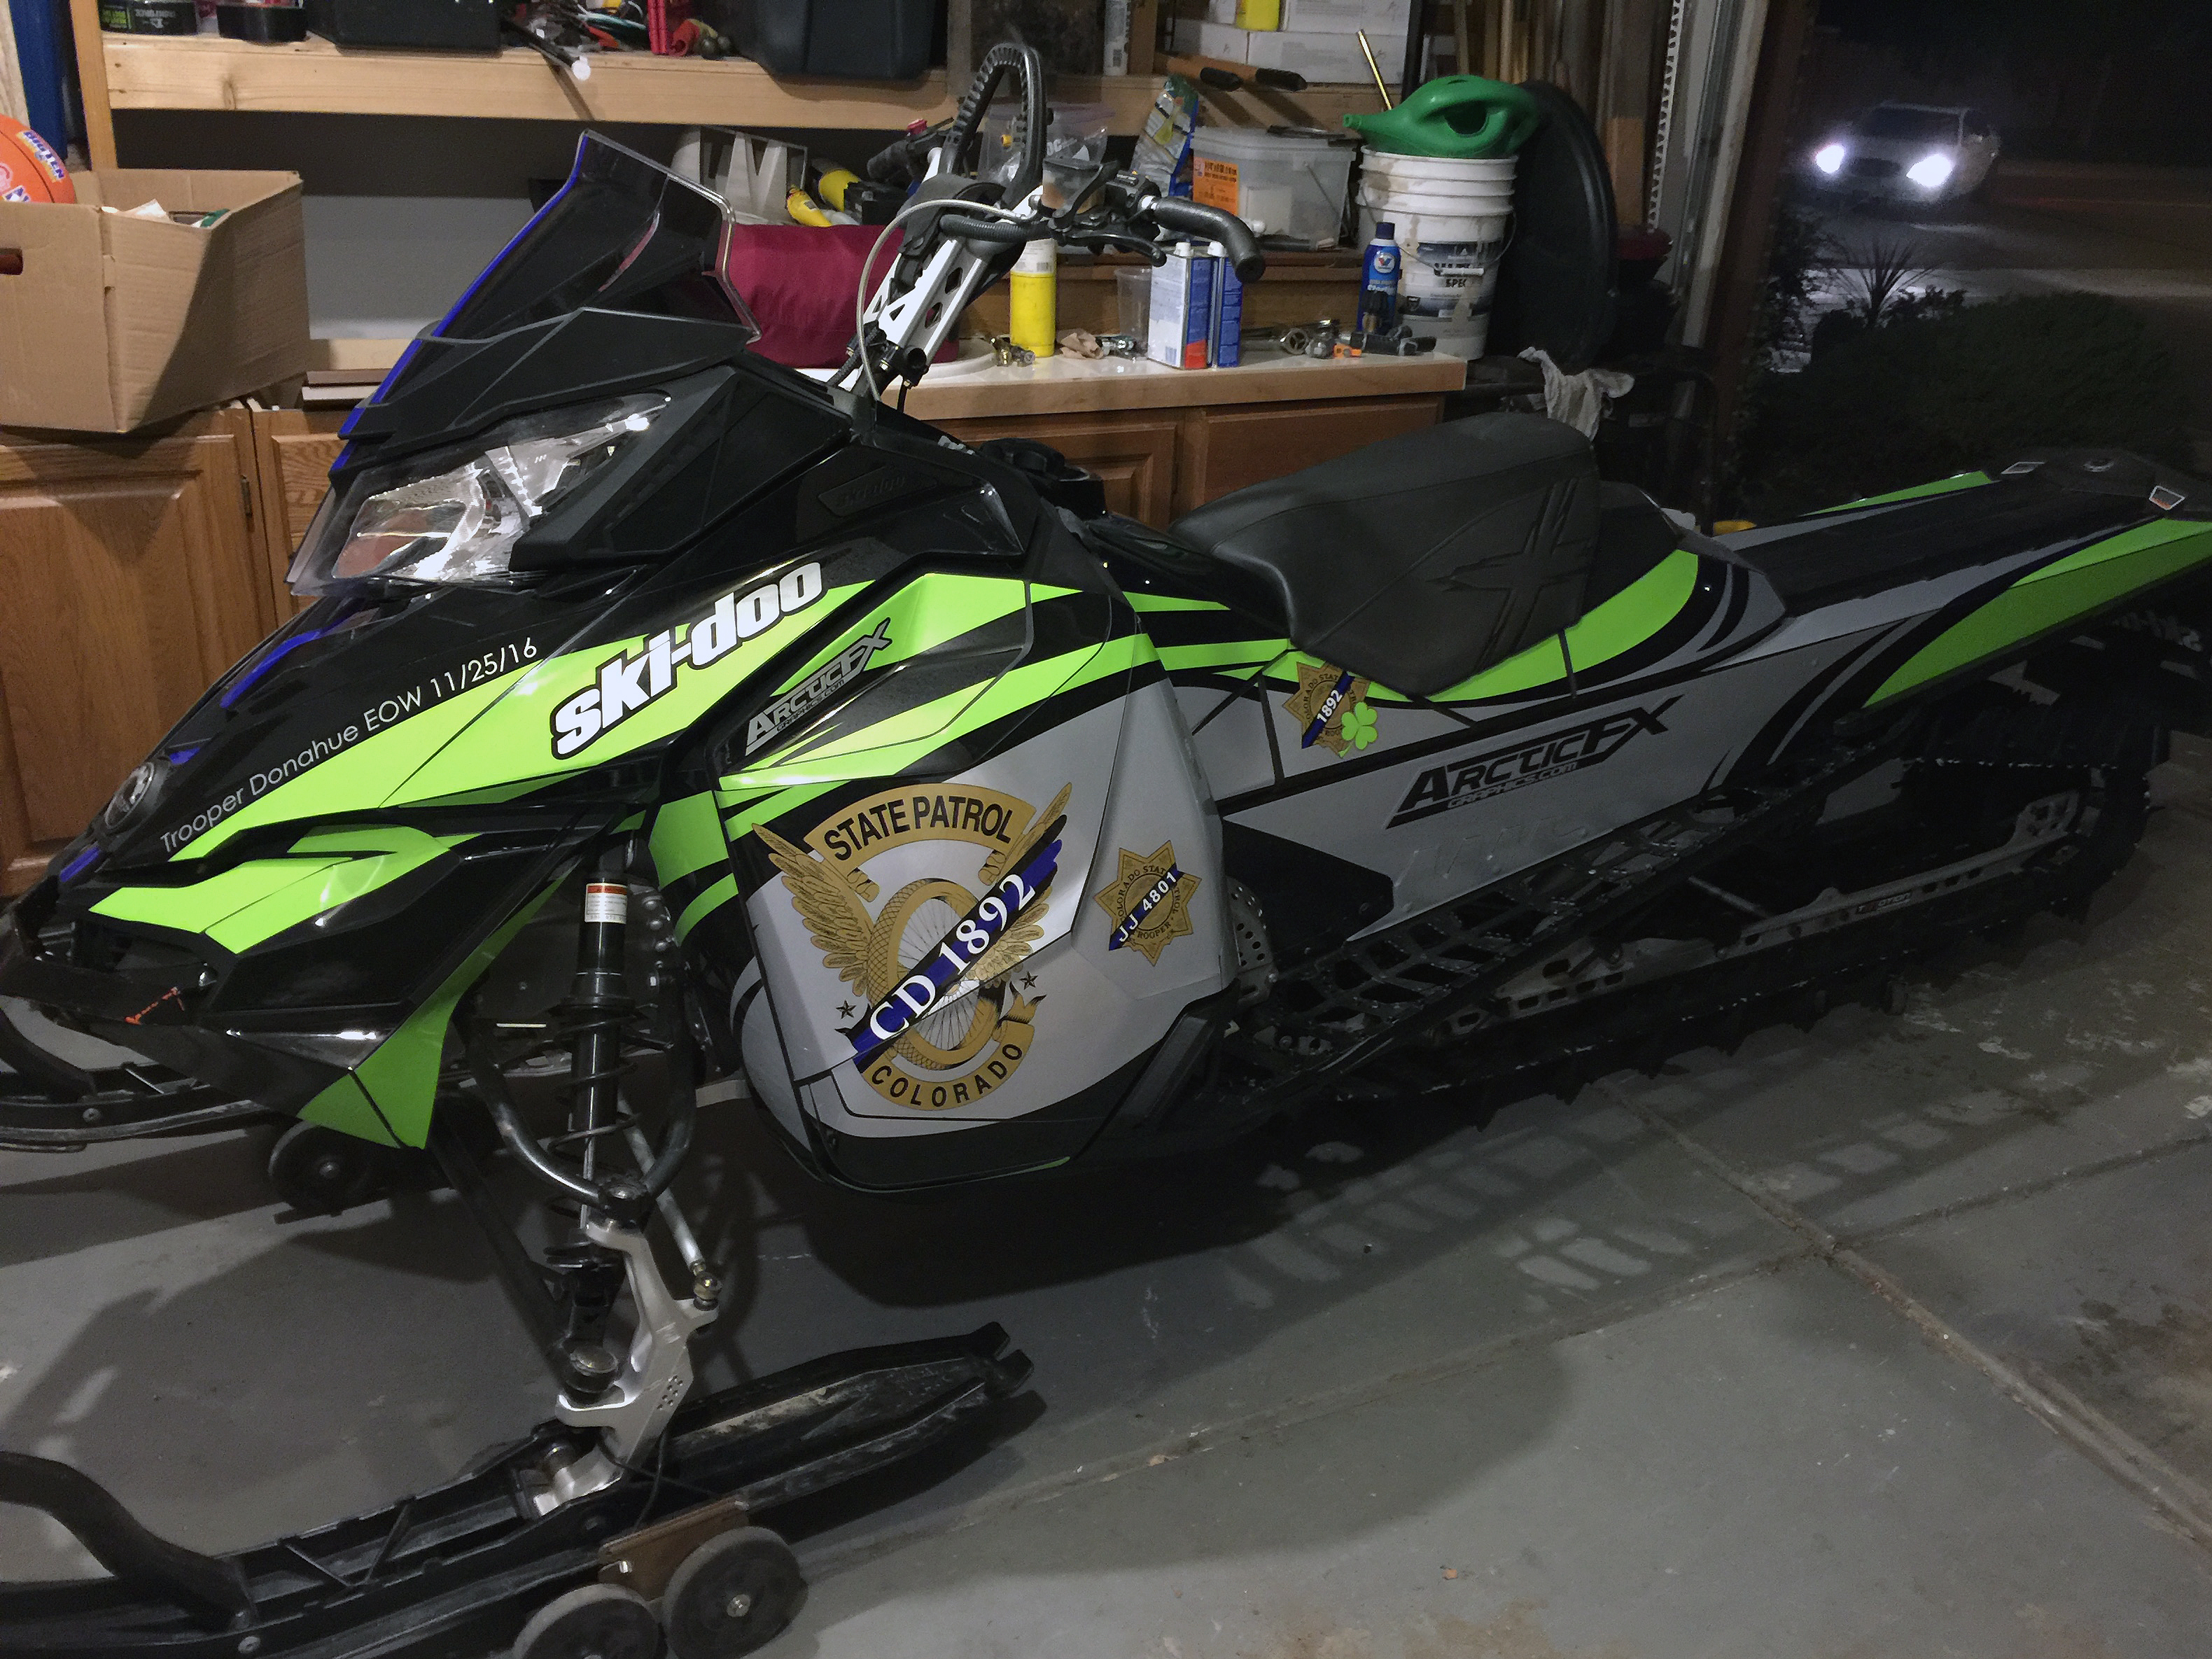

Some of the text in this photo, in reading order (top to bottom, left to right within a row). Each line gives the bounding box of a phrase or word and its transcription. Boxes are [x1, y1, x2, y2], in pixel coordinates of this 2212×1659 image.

[1317, 690, 1343, 723] 1892
[160, 636, 538, 853] Trooper Donahue EOW 11/25/16
[823, 795, 1013, 862] STATE PATROL
[1142, 864, 1166, 875] STAT
[1142, 872, 1177, 911] 4801
[1135, 921, 1172, 939] ROOPER
[868, 874, 1035, 1042] CD 1892
[871, 1042, 1023, 1108] COLORADO
